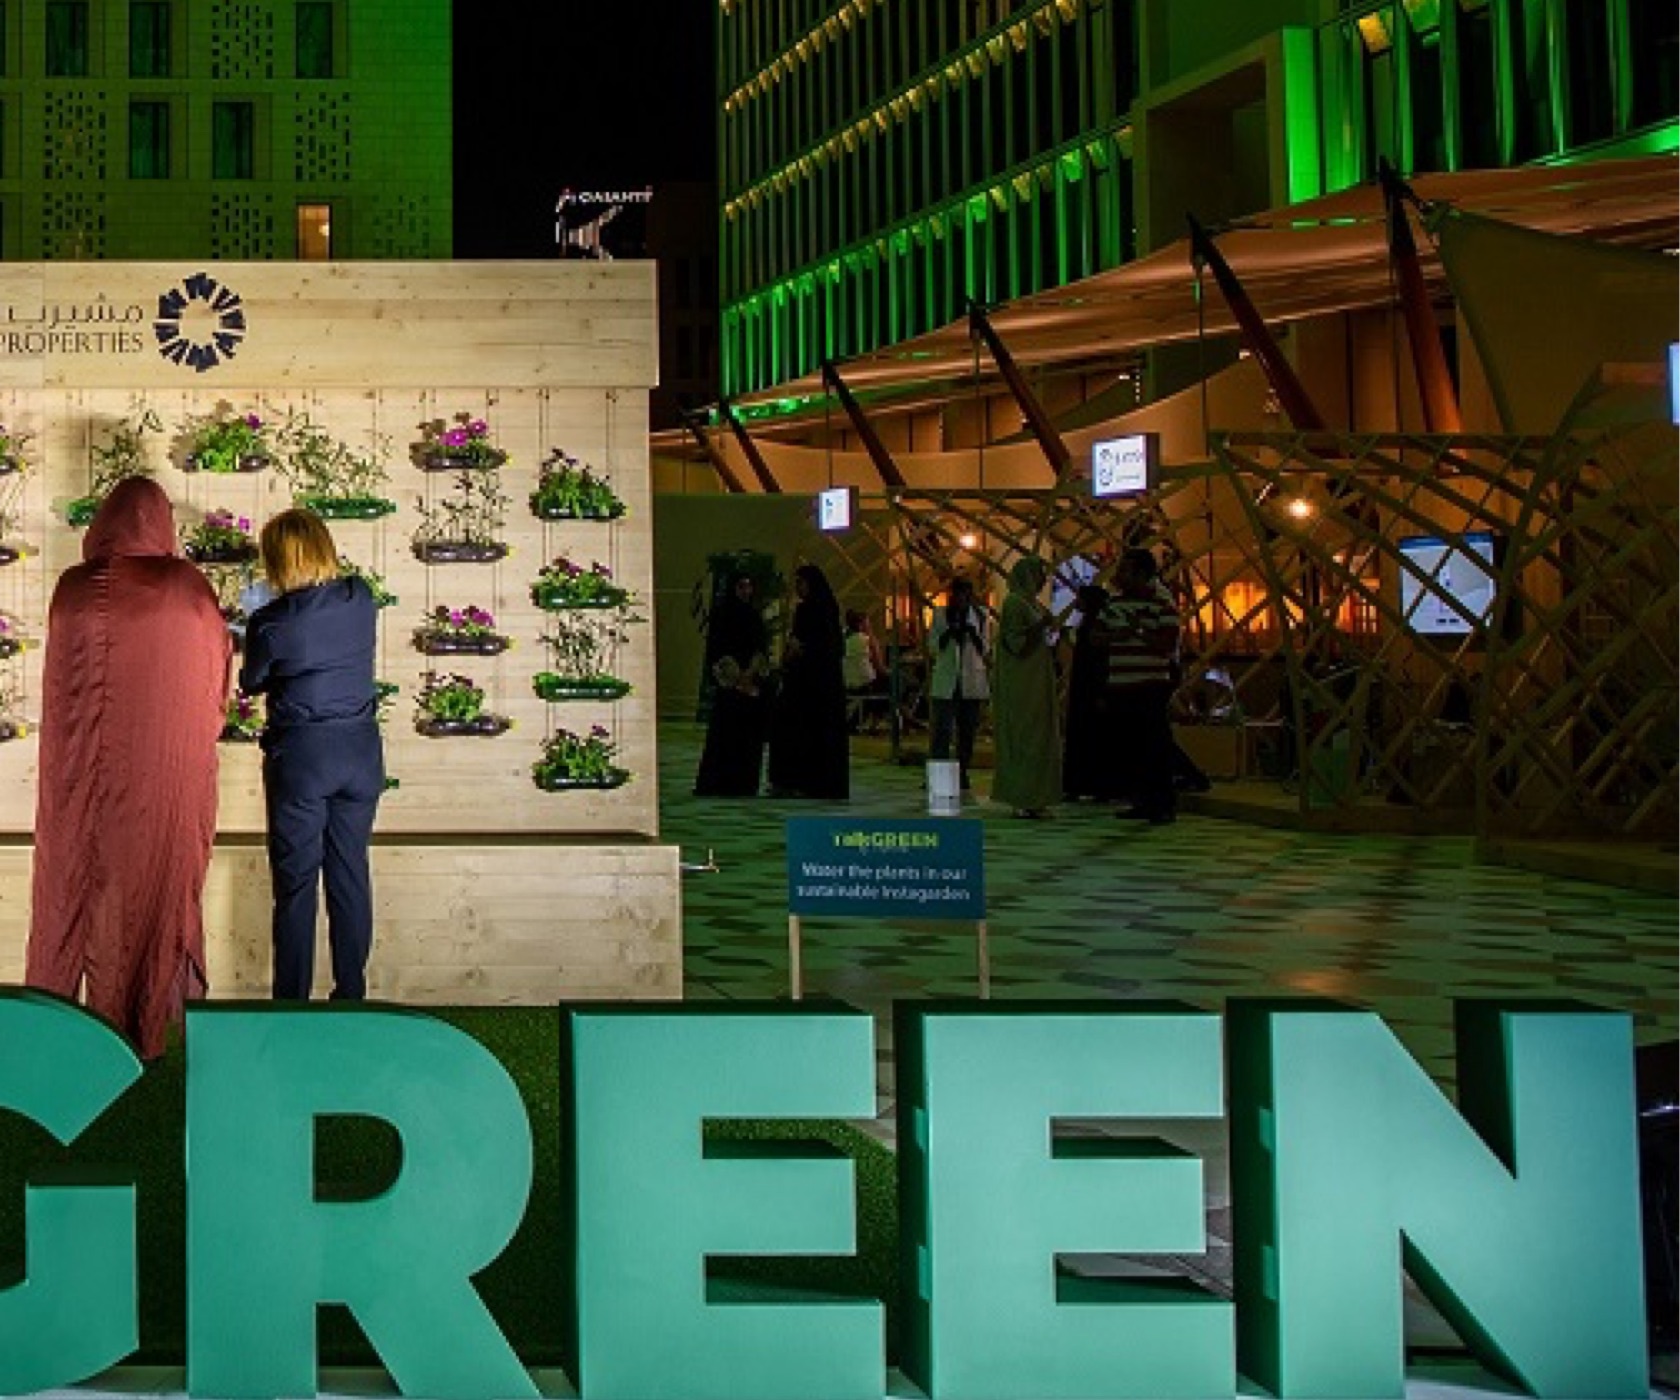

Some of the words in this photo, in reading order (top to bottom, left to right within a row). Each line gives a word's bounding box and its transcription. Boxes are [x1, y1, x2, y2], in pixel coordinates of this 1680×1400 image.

[8, 292, 144, 330] مشيرب
[801, 862, 844, 878] Water
[848, 863, 873, 879] the
